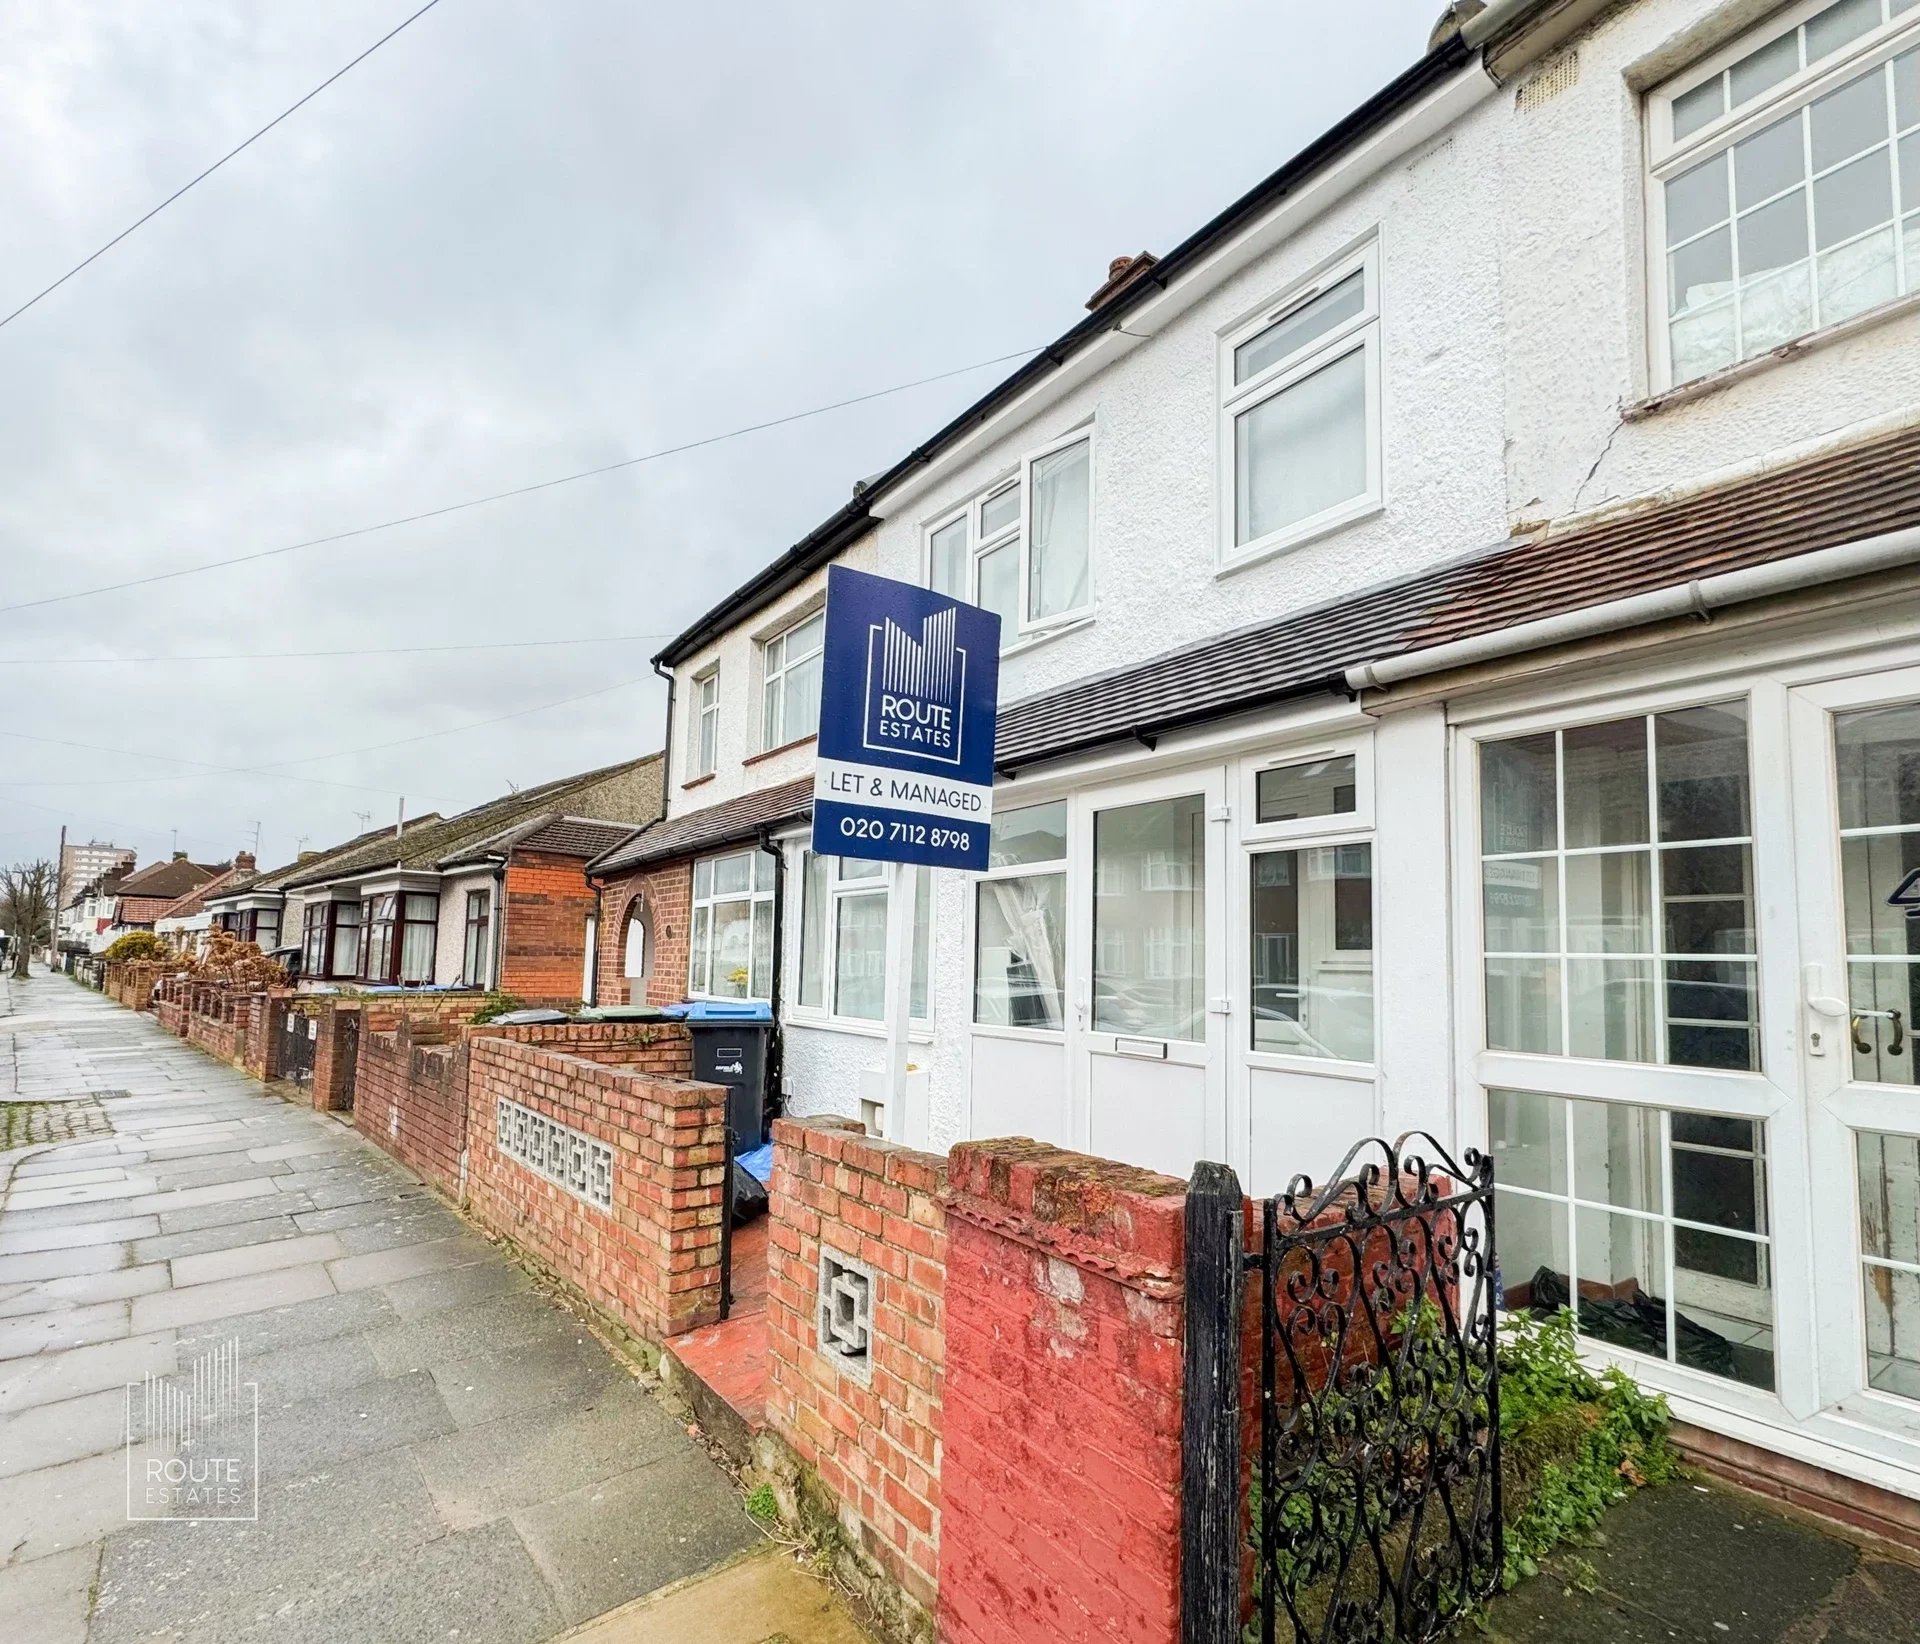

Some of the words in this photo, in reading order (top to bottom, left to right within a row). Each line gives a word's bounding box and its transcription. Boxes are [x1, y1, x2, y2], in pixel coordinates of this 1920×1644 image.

[881, 694, 952, 731] ROUTE
[879, 719, 951, 749] ESTATES
[830, 771, 865, 794] LET
[869, 777, 883, 797] &
[890, 779, 982, 812] MANAGED
[840, 816, 884, 840] 020
[889, 822, 926, 845] 7112
[930, 828, 970, 852] 8798
